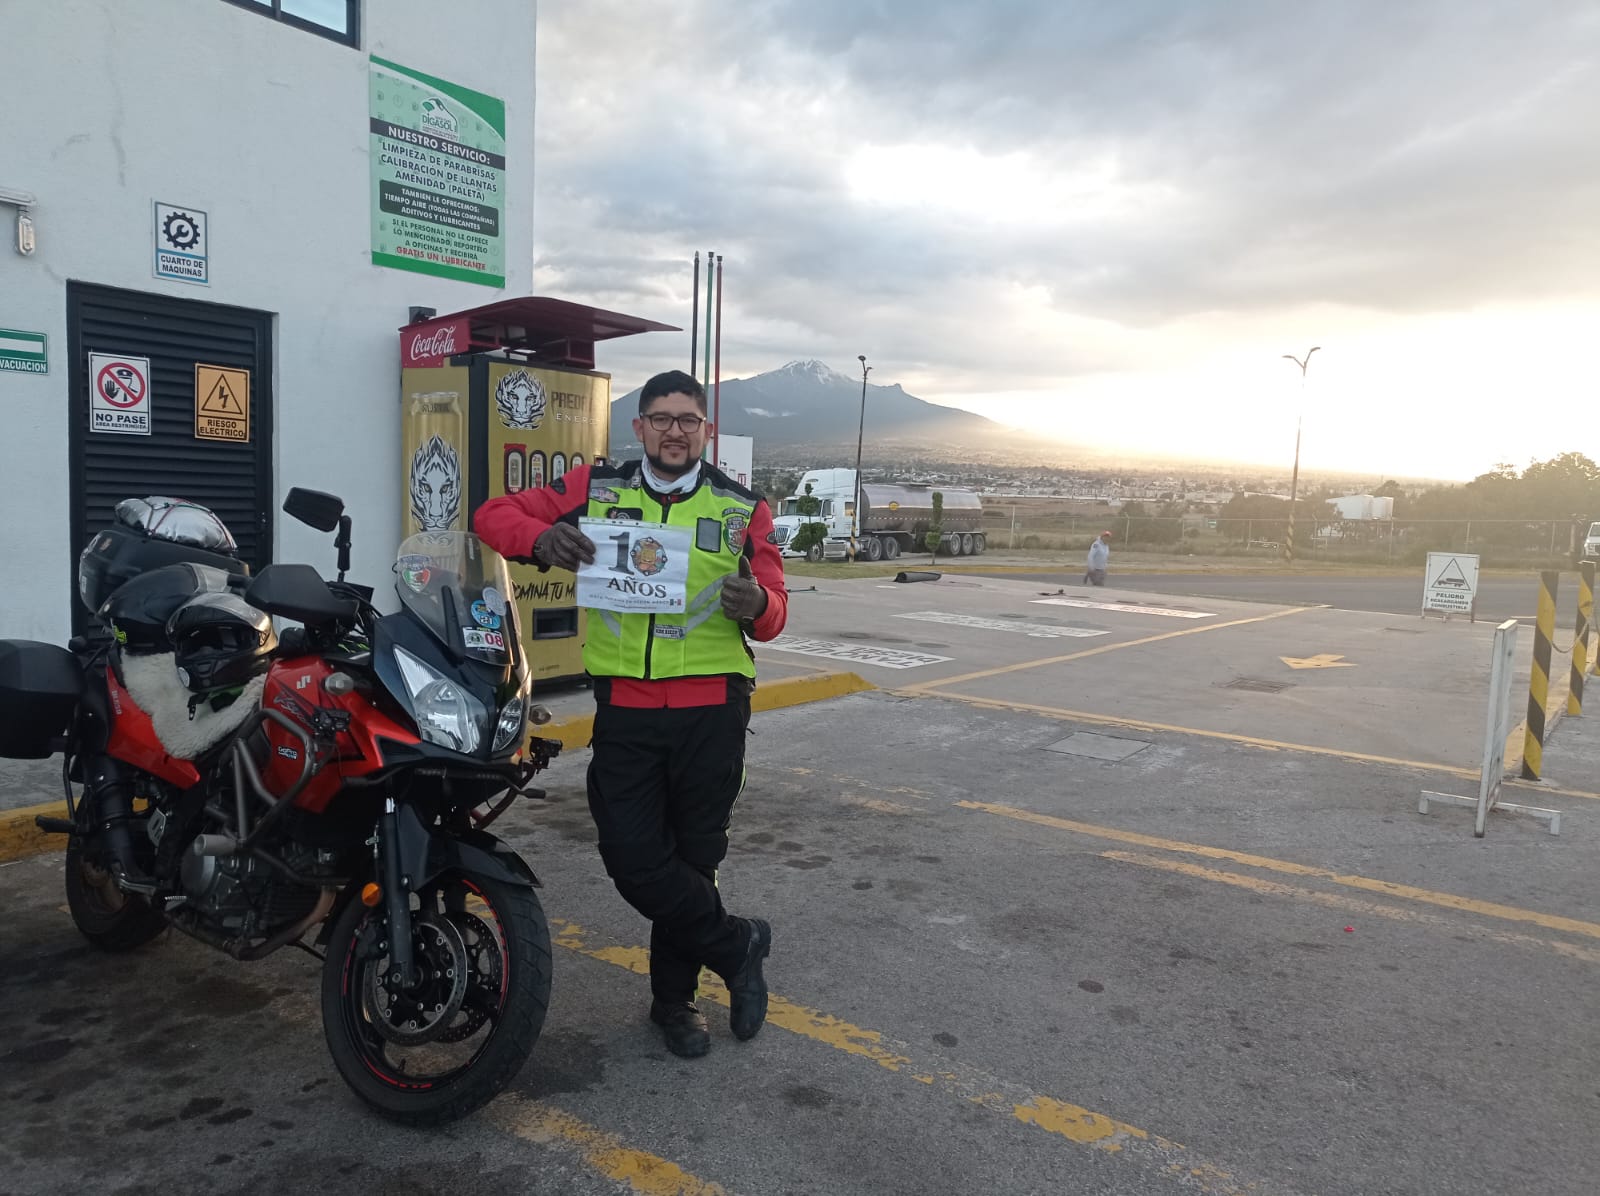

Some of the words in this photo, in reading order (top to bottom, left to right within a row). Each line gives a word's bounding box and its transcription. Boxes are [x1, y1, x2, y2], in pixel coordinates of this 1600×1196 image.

[388, 126, 438, 149] NUESTRO
[441, 142, 491, 165] SERVICIO:
[382, 141, 427, 162] LIMPIEZA
[429, 155, 441, 166] DE
[444, 159, 496, 181] PARABRISAS
[381, 154, 444, 178] CALIBRACIÓN
[447, 171, 459, 182] DE
[461, 174, 497, 192] LLANTAS
[395, 170, 446, 191] AMENIDAD
[448, 183, 485, 201] (PALETA)
[384, 192, 410, 205] TIEMPO
[411, 200, 426, 209] AIRE
[428, 203, 449, 215] (TODAS
[450, 209, 460, 218] LAS
[432, 195, 440, 203] LE
[441, 198, 480, 213] OFRECEMOS:
[401, 206, 433, 219] ADITIVOS
[433, 211, 439, 220] Y
[440, 215, 480, 230] LUBRICANTES
[393, 228, 402, 236] LO
[401, 220, 408, 228] EL
[410, 222, 444, 236] PERSONAL
[445, 229, 456, 238] NO
[458, 232, 464, 241] LE
[466, 235, 489, 246] OFRECE
[405, 239, 410, 247] A
[411, 240, 443, 254] OFICINAS
[444, 247, 449, 255] Y
[160, 255, 192, 267] CUARTO
[193, 260, 204, 269] DE
[396, 246, 425, 258] GRATIS
[427, 252, 439, 262] UN
[441, 255, 486, 271] LUBRICANTE
[0, 359, 47, 373] VACUACION
[95, 413, 113, 422] NO
[116, 414, 146, 425] PASE
[207, 419, 237, 429] RIESGO
[550, 581, 564, 603] TU
[606, 576, 667, 599] AÑOS
[484, 632, 504, 648] 08
[785, 646, 914, 667] TANQUE
